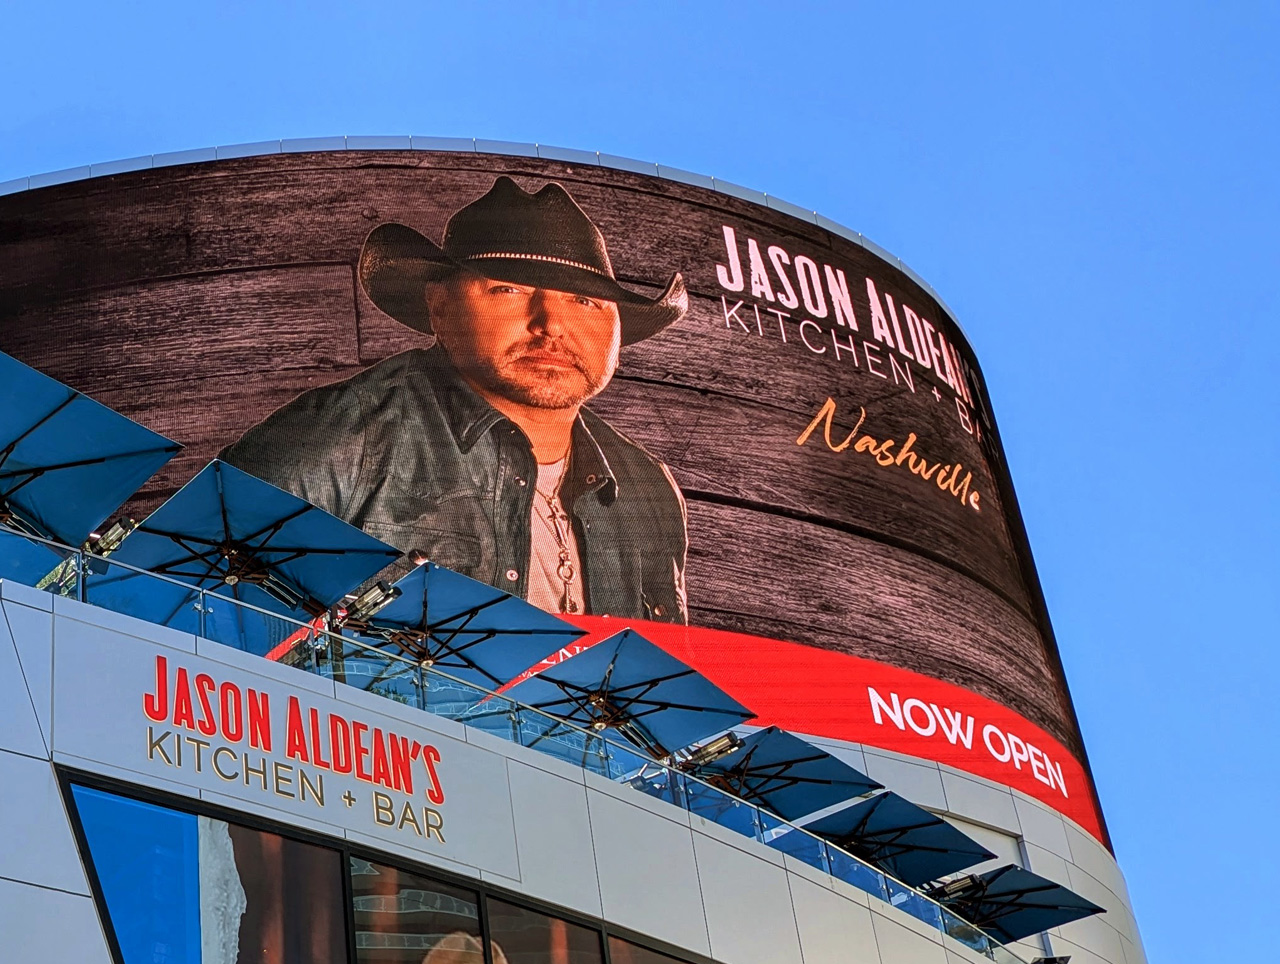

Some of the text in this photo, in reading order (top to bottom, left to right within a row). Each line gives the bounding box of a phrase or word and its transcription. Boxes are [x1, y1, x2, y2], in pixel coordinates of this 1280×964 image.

[716, 225, 991, 430] JASON ALDEAN'S
[720, 296, 916, 394] KITCHEN
[796, 397, 982, 512] Nashville
[144, 655, 446, 805] JASON ALDEAN'S
[146, 725, 447, 844] KITCHEN + BAR
[867, 686, 1068, 799] NOW OPEN
